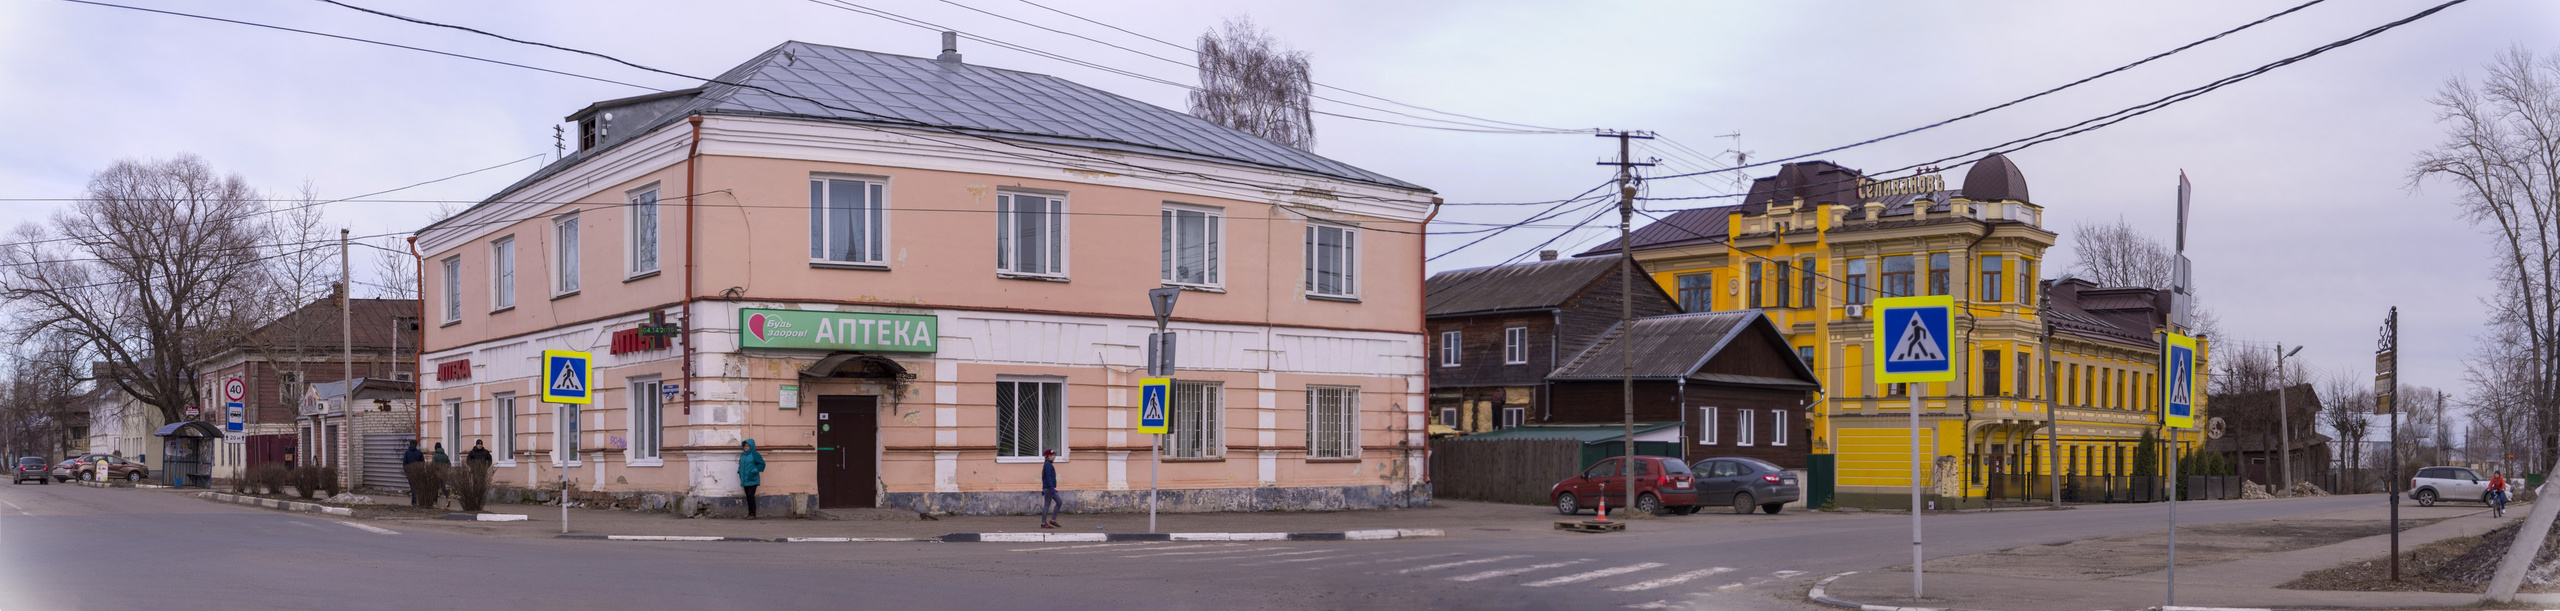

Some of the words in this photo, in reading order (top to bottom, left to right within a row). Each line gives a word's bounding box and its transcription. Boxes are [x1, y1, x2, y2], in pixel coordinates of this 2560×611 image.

[767, 320, 792, 329] Будь
[815, 317, 932, 347] АПТЕКА
[437, 359, 471, 381] АПТЕКА
[230, 385, 241, 394] 40
